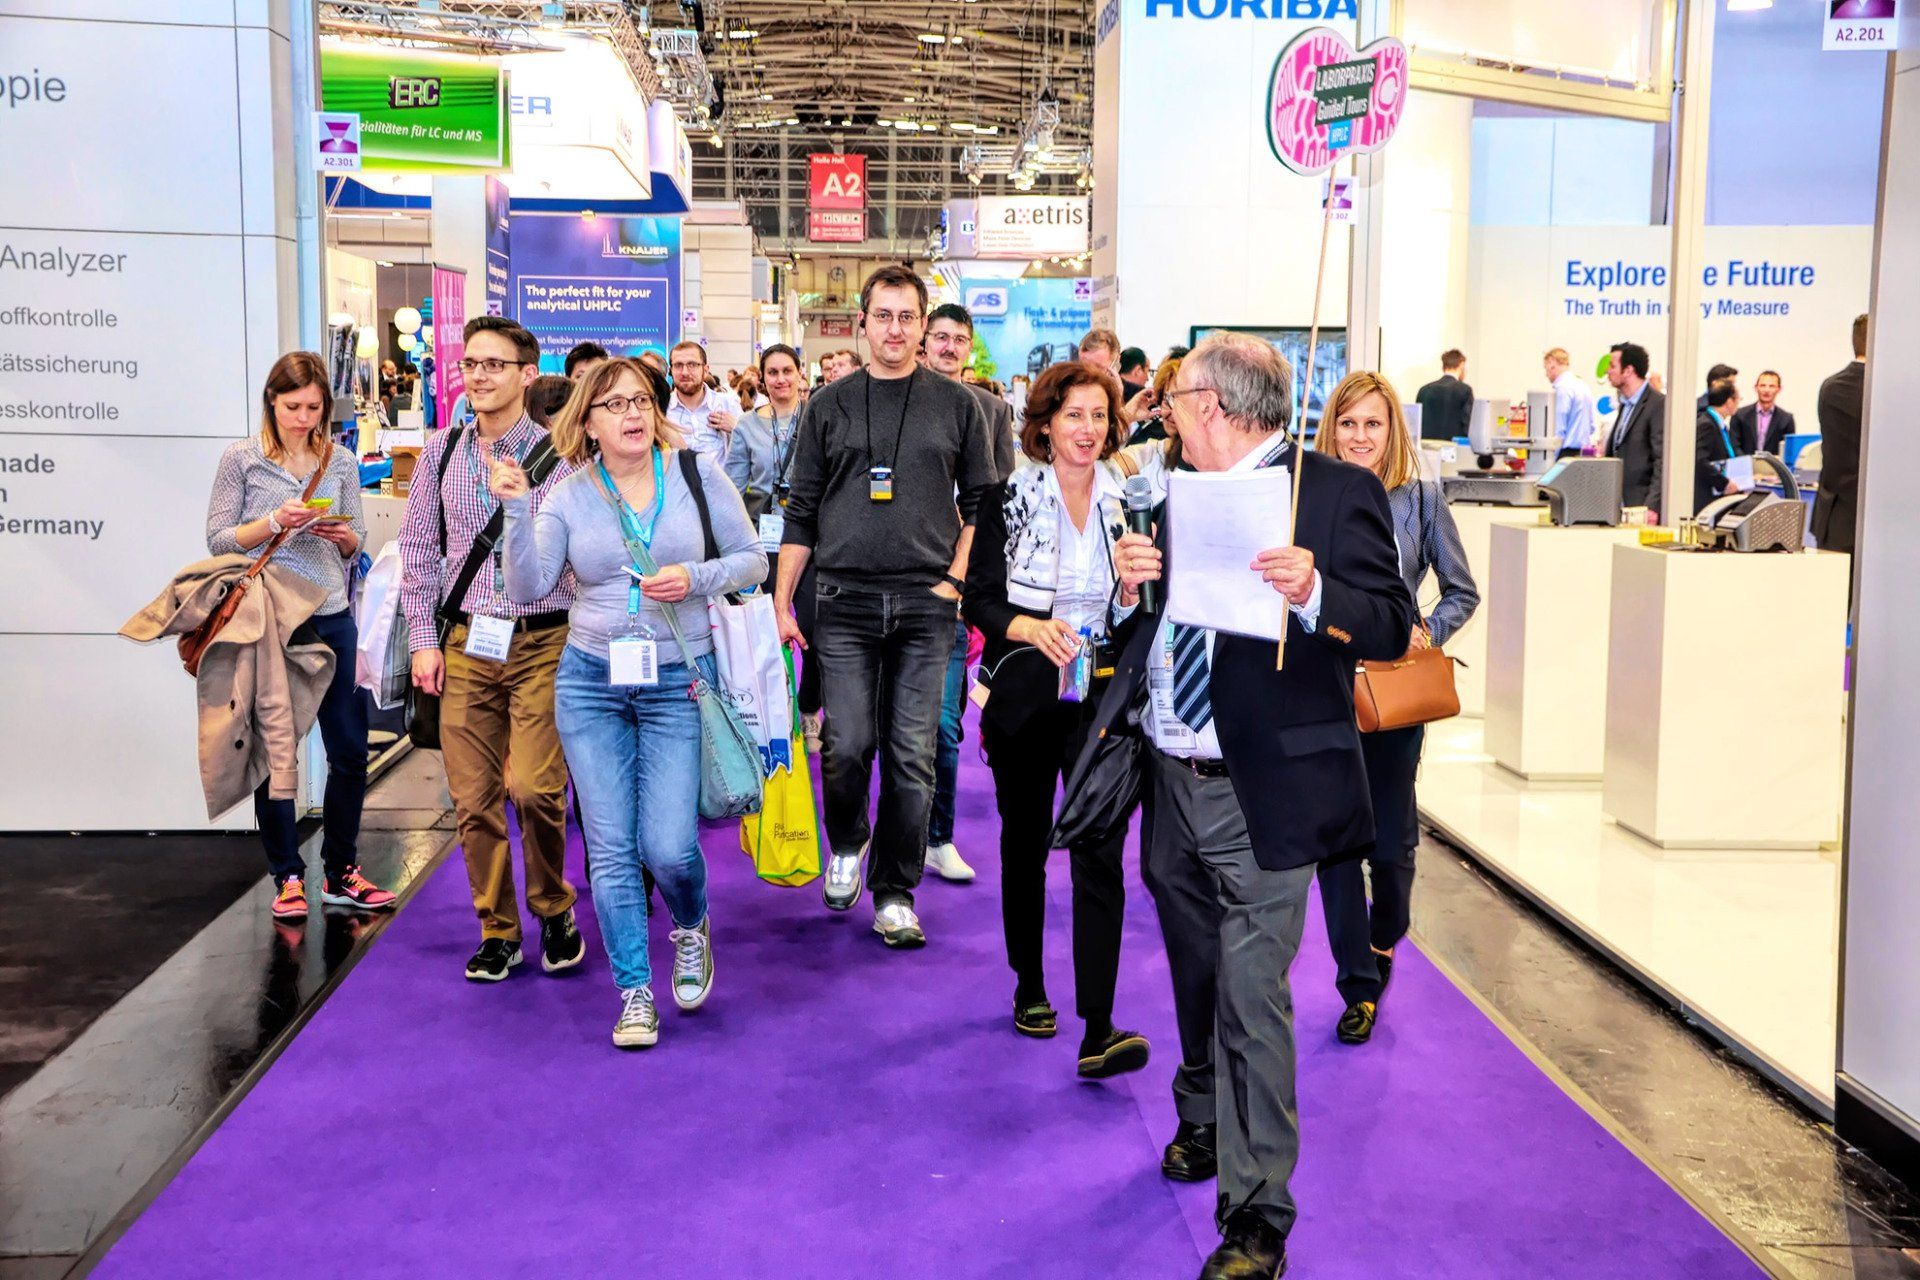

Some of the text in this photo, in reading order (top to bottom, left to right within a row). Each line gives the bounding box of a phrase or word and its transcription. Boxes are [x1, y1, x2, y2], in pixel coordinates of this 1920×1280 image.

[1835, 27, 1884, 41] A2.201
[0, 67, 66, 108] pie
[1315, 63, 1376, 91] LABORPRAXIS
[394, 79, 439, 107] ERC
[1316, 95, 1369, 121] Guided Tours
[410, 124, 426, 139] für
[428, 128, 441, 139] LC
[442, 129, 463, 141] und
[465, 130, 483, 142] MS
[324, 157, 353, 167] A2.301
[822, 171, 861, 198] A2
[0, 244, 127, 278] Analyzer
[1566, 260, 1666, 291] Explore
[1727, 260, 1816, 286] Future
[525, 284, 651, 300] The perfect fit for your
[527, 298, 622, 314] analytical UHPLC
[1565, 299, 1594, 316] The
[1599, 299, 1641, 316] Truth
[1646, 299, 1662, 316] in
[1717, 300, 1789, 316] Measure
[0, 353, 138, 380] ätssicherung
[0, 400, 120, 421] sskontrolle
